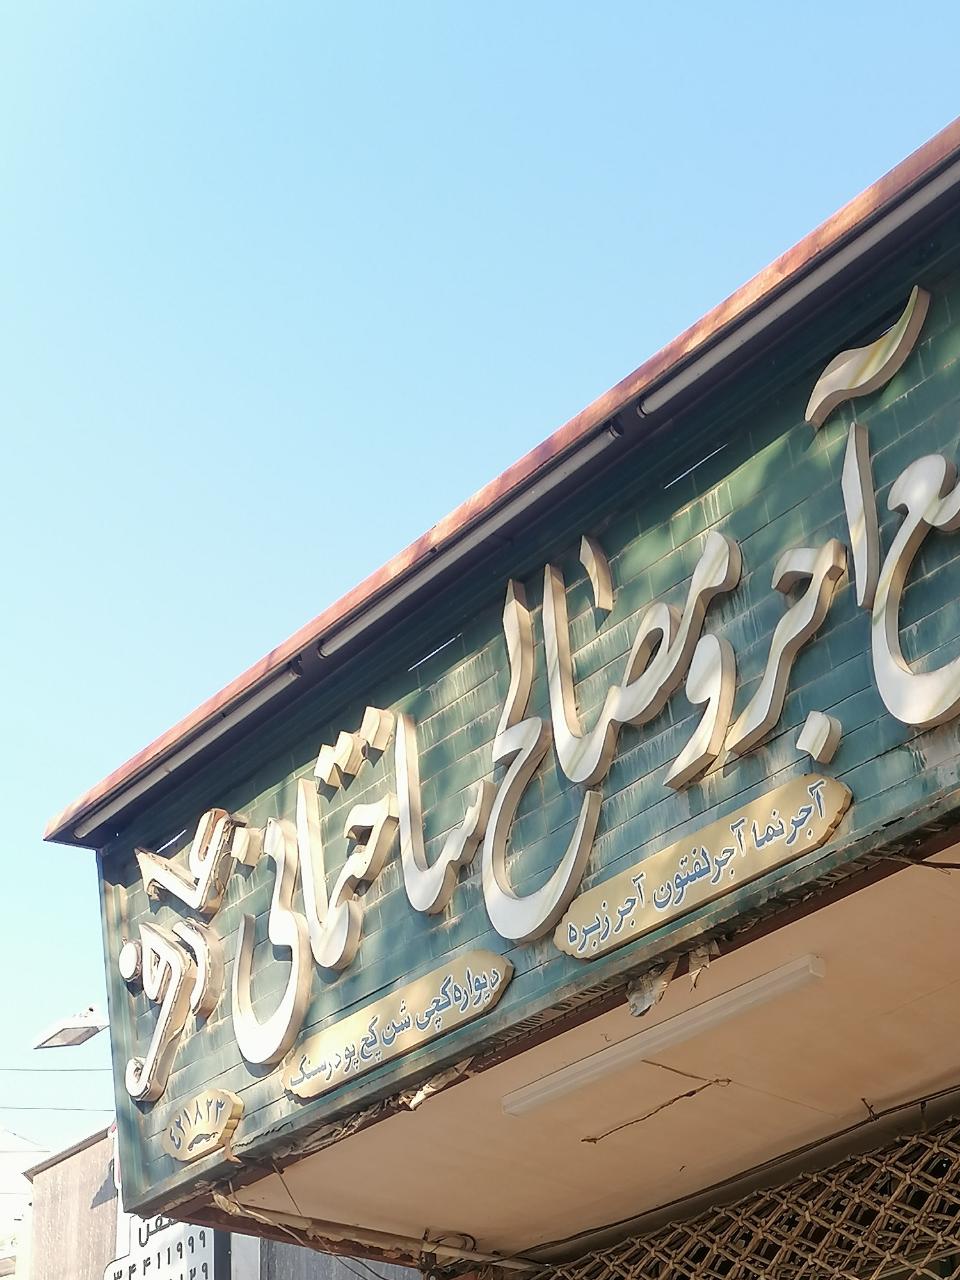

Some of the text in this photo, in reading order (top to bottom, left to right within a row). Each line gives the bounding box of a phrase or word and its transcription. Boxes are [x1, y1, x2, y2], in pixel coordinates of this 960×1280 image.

[724, 285, 931, 764] آجر
[482, 532, 743, 940] مصالح
[663, 634, 738, 790] و
[231, 706, 497, 1064] ساختمانی
[453, 967, 502, 1013] دیواره
[381, 1000, 412, 1047] شن
